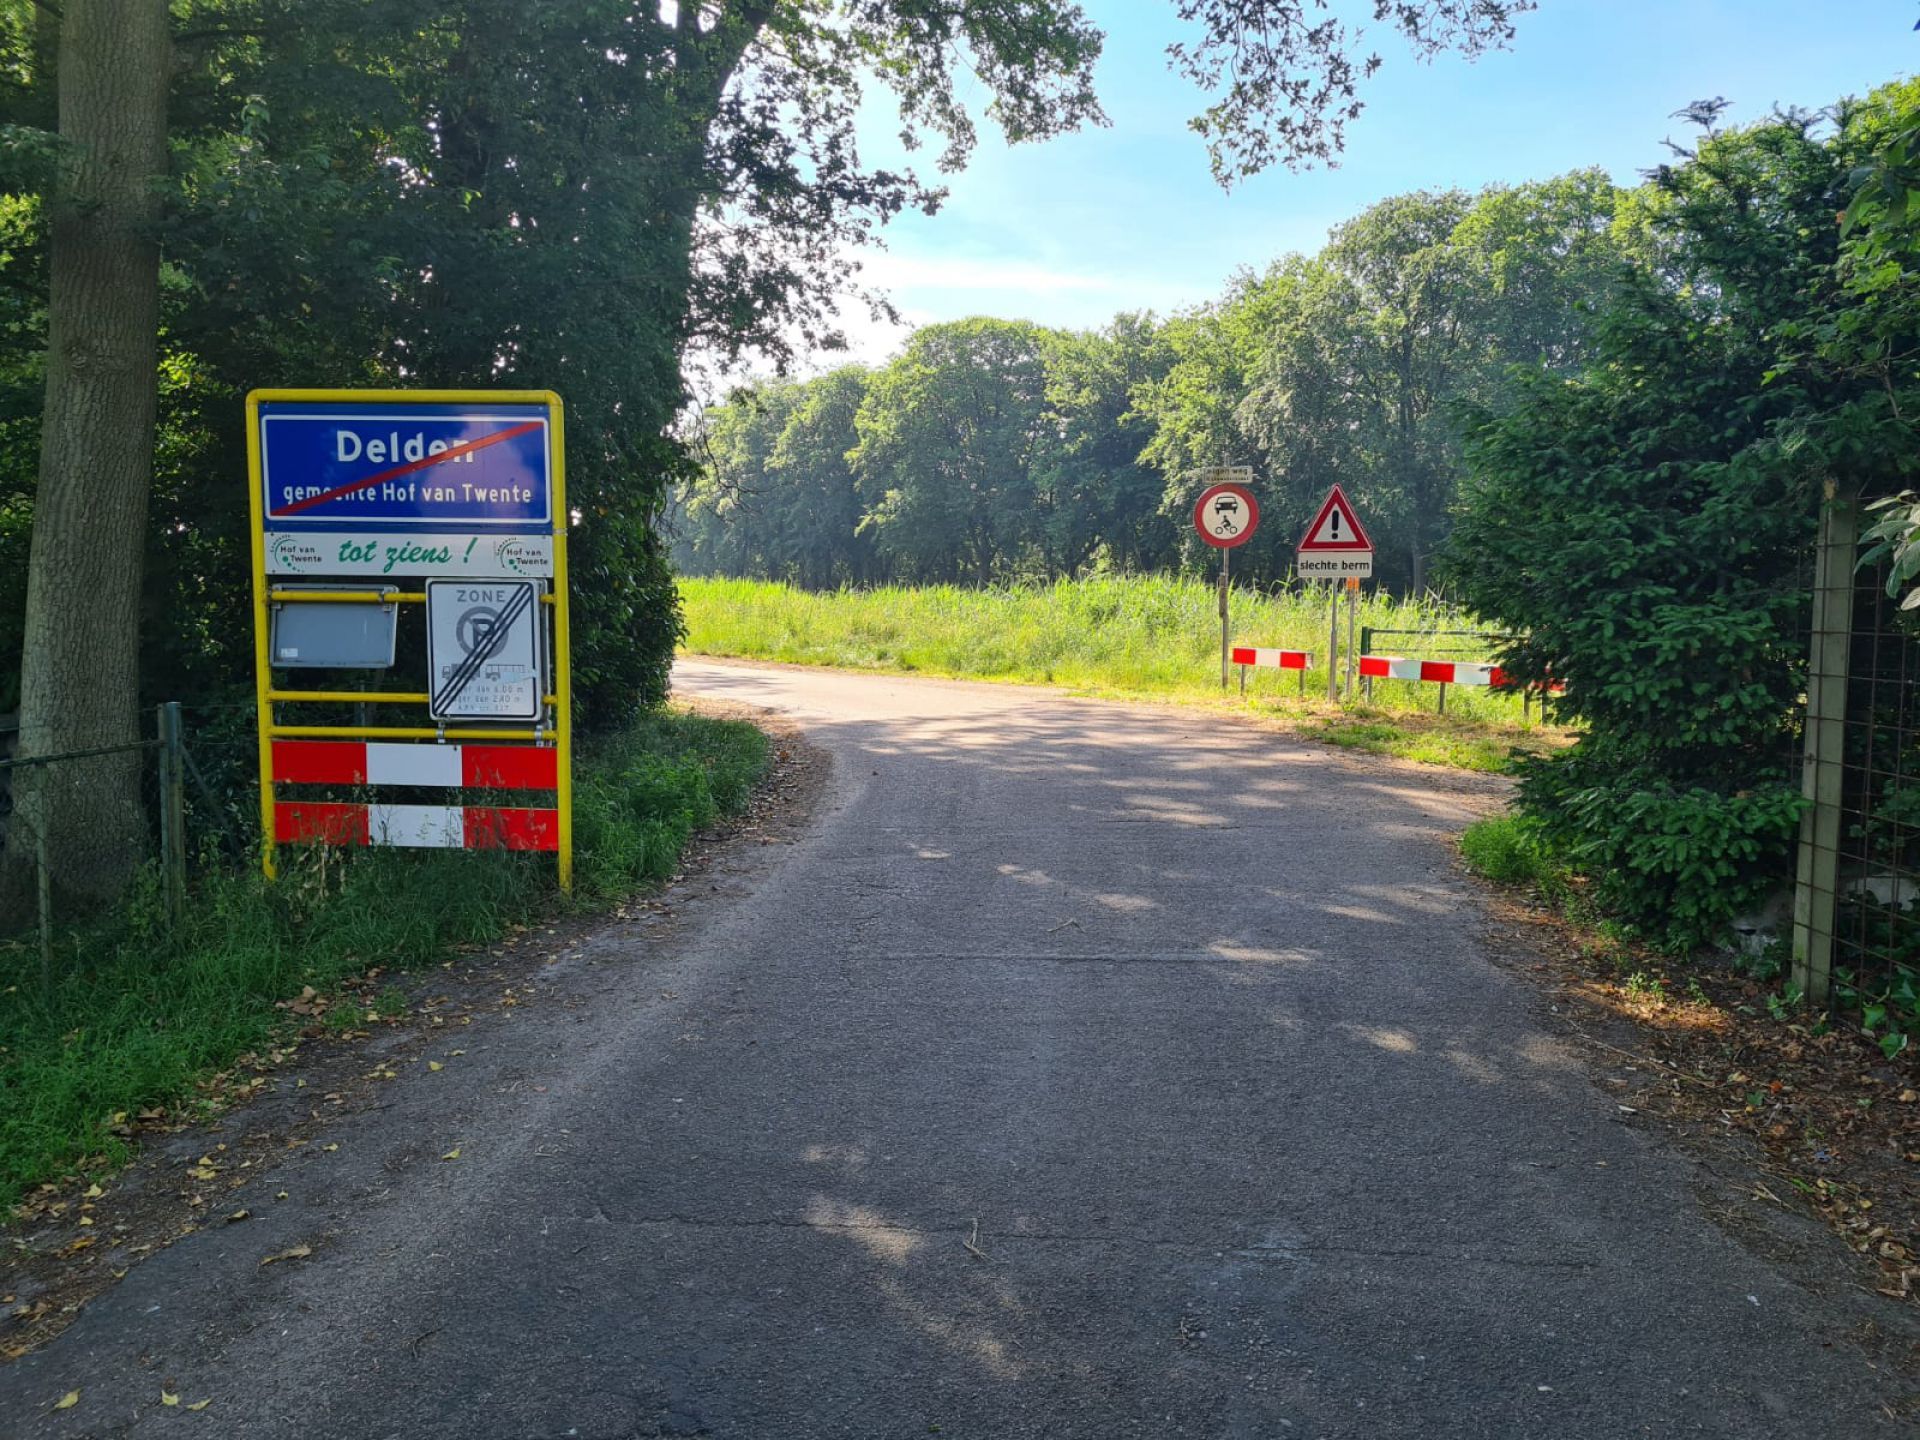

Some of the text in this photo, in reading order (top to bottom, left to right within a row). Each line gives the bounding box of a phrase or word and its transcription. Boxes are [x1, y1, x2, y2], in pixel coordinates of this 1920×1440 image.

[336, 430, 474, 463] Delden
[283, 482, 531, 505] gemnte Hof van Twente
[338, 540, 377, 562] tot
[383, 541, 452, 574] ziens
[463, 537, 478, 563] !
[507, 548, 522, 556] Hof
[516, 557, 548, 565] Twente
[1300, 560, 1370, 570] slechte berm
[456, 589, 506, 603] ZONE
